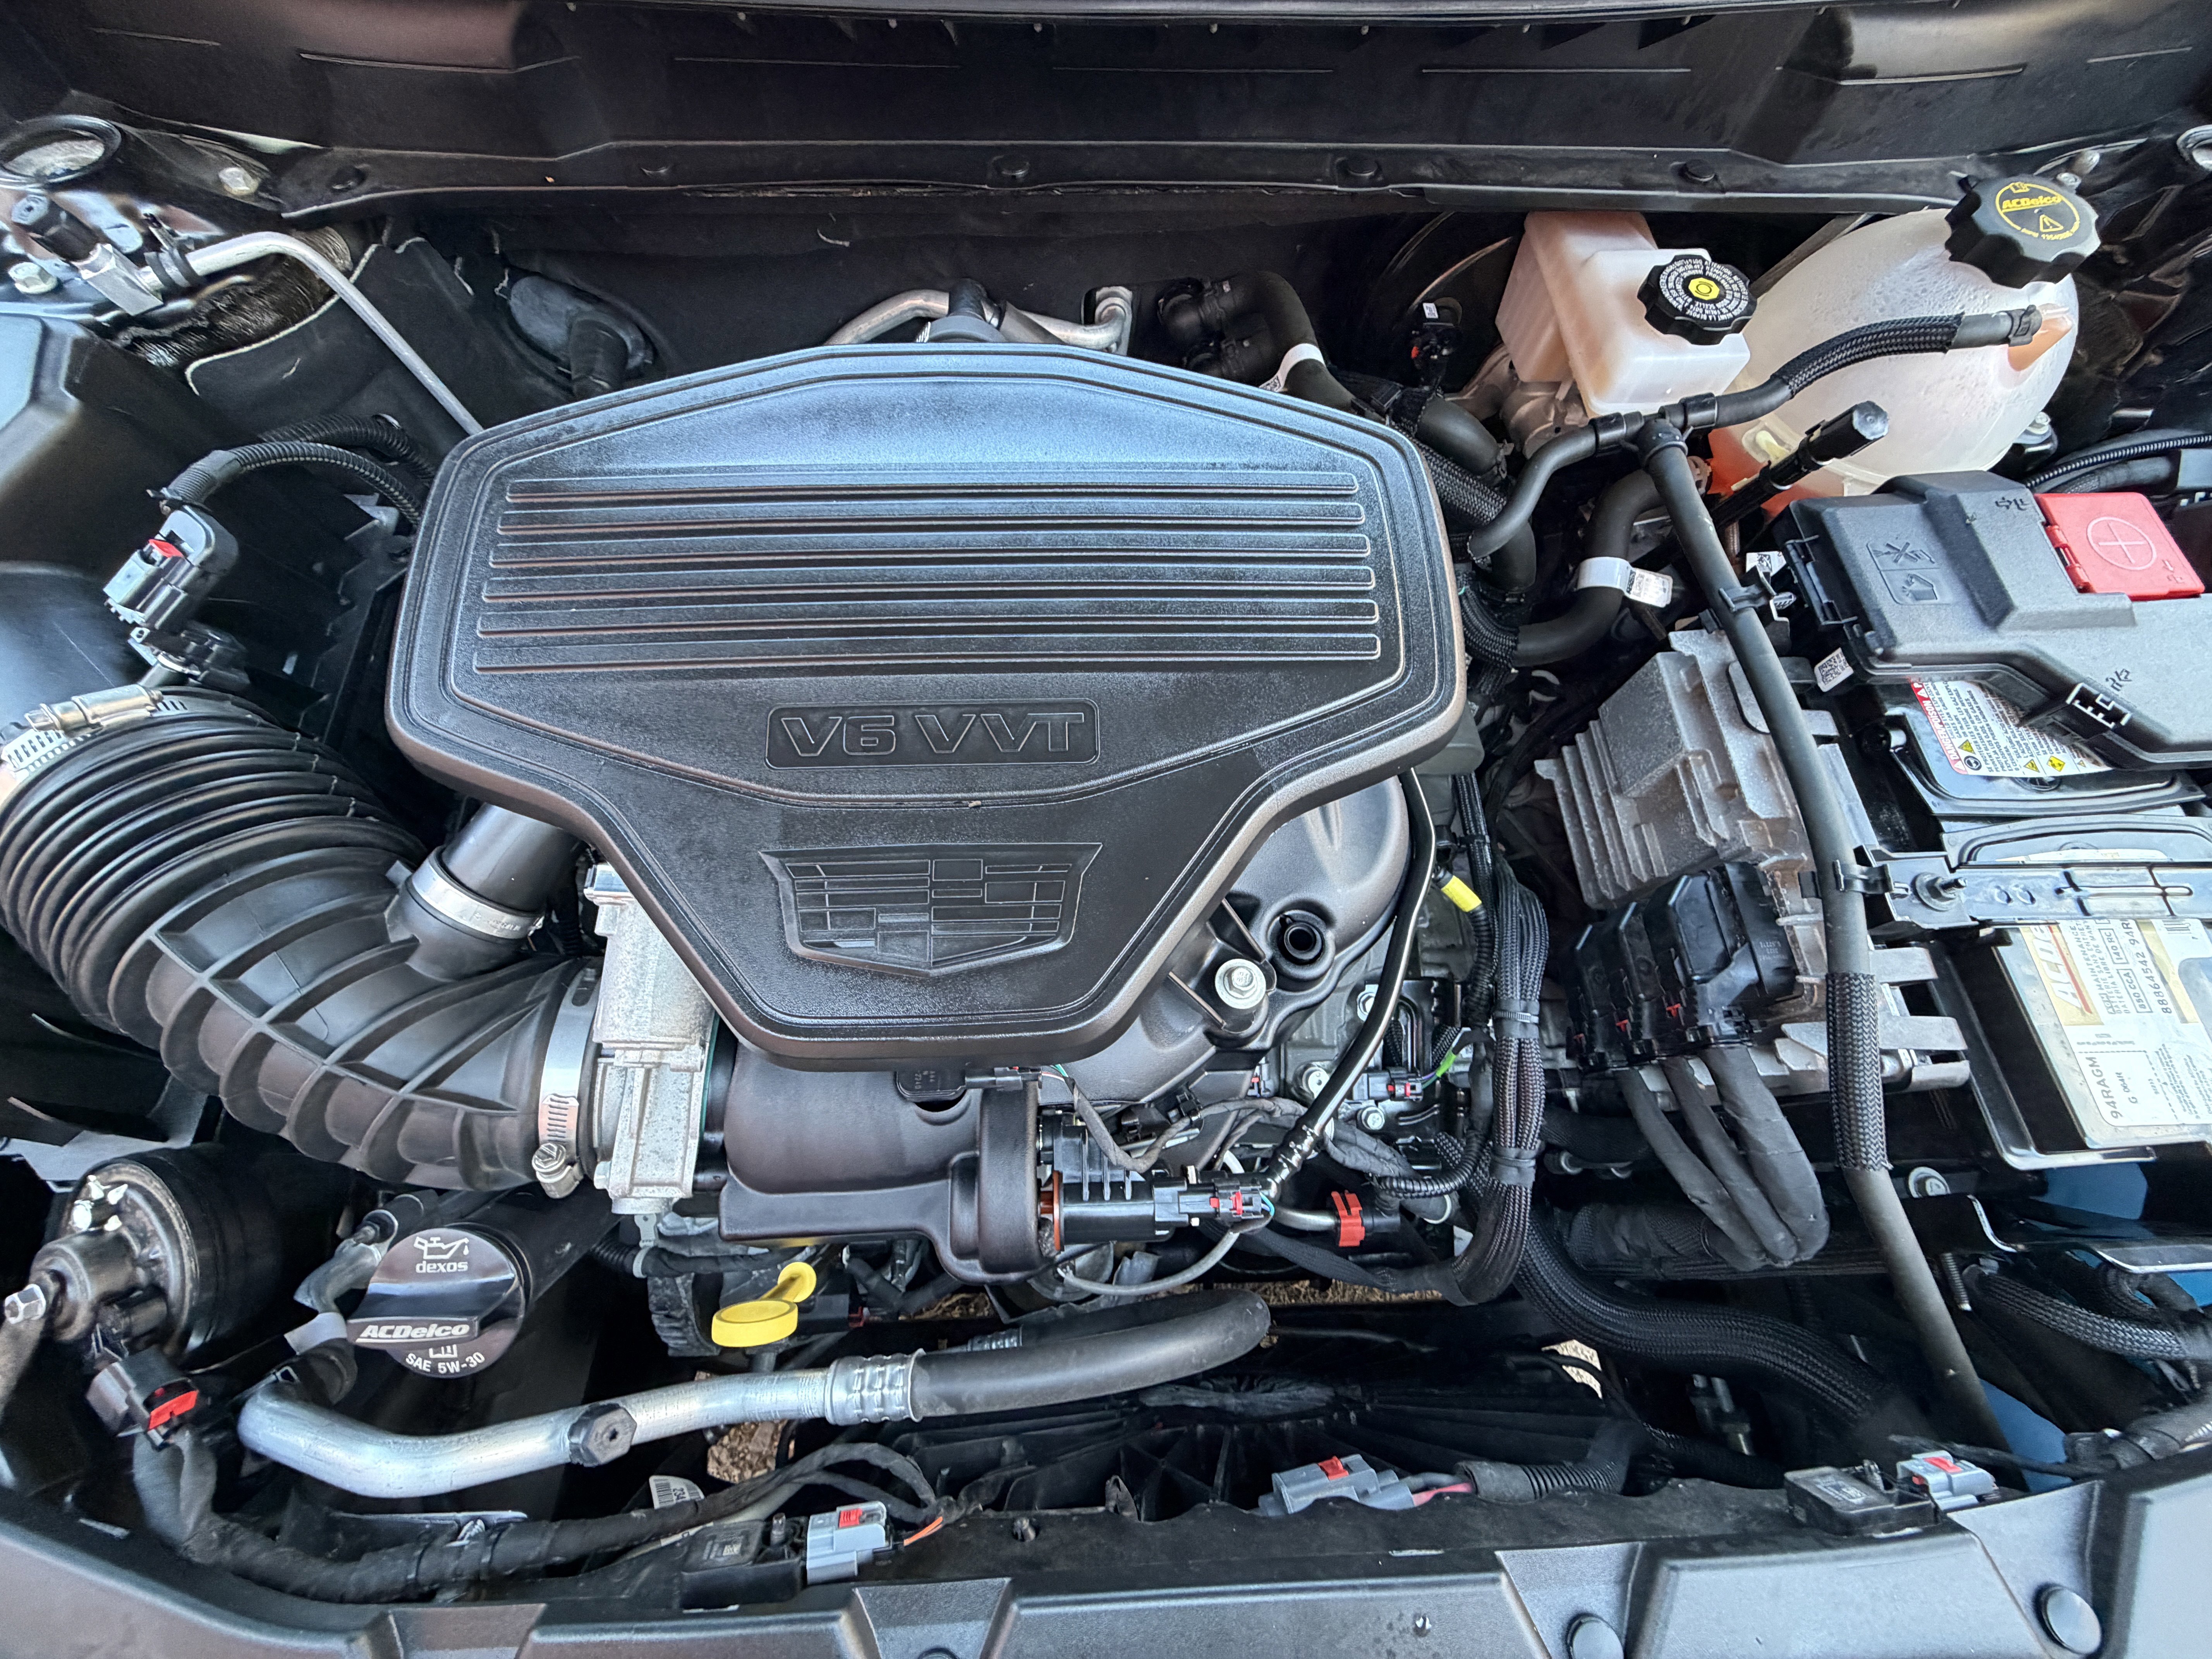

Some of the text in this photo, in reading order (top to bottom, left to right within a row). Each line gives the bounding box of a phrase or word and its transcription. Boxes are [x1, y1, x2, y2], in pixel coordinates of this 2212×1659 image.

[1937, 697, 1948, 710] CAUSE
[1955, 707, 1964, 715] LES
[1964, 698, 1976, 713] GASES
[1945, 712, 1953, 721] CAN
[1973, 715, 1982, 723] LOS
[781, 712, 1085, 757] V6 VVT
[1923, 701, 1960, 759] DANGER/POISON
[1950, 723, 1962, 738] GASES
[1968, 731, 1977, 739] LES
[1986, 740, 1995, 749] LOS
[1986, 752, 2000, 771] PEUVENT
[1994, 741, 2013, 771] EXPLOSIVOS
[2104, 932, 2123, 960] 140 RC
[2033, 926, 2082, 1007] ACDe
[2073, 926, 2104, 990] MAINTENANCE
[2123, 972, 2136, 989] CCA
[2135, 951, 2172, 1013] 88864542
[2085, 1056, 2123, 1118] 94RAGM
[416, 1261, 468, 1273] dexos
[359, 1324, 471, 1338] ACDelco
[405, 1352, 485, 1374] SAE 5W-30
